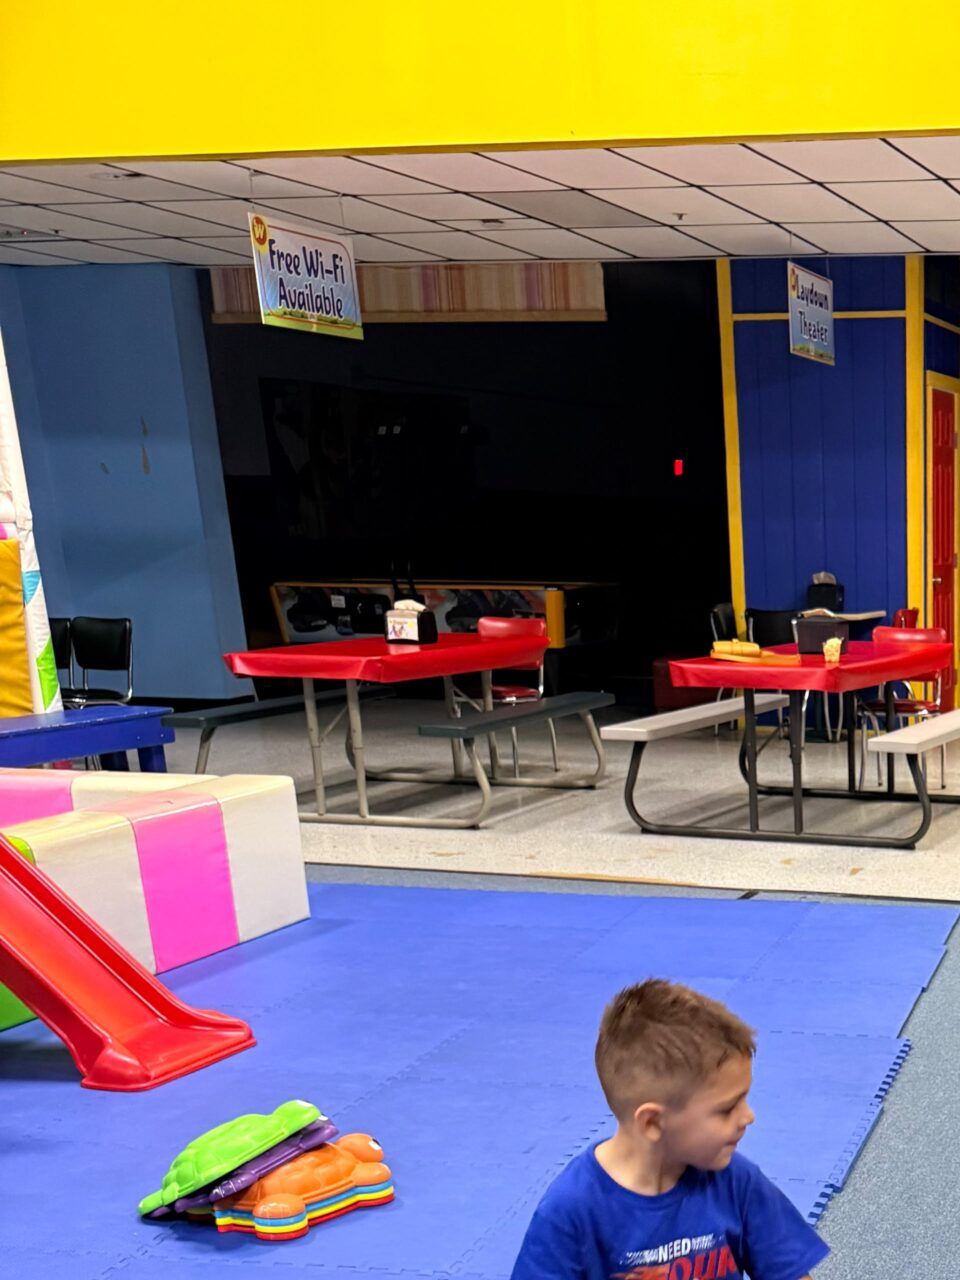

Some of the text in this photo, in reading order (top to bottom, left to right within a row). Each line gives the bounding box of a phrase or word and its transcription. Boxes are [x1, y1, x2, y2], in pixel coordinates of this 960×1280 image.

[268, 239, 345, 284] Free Wi-Fi
[278, 277, 344, 319] Available
[796, 274, 829, 311] Laydown
[798, 310, 828, 343] Theater
[658, 1237, 692, 1263] NEED
